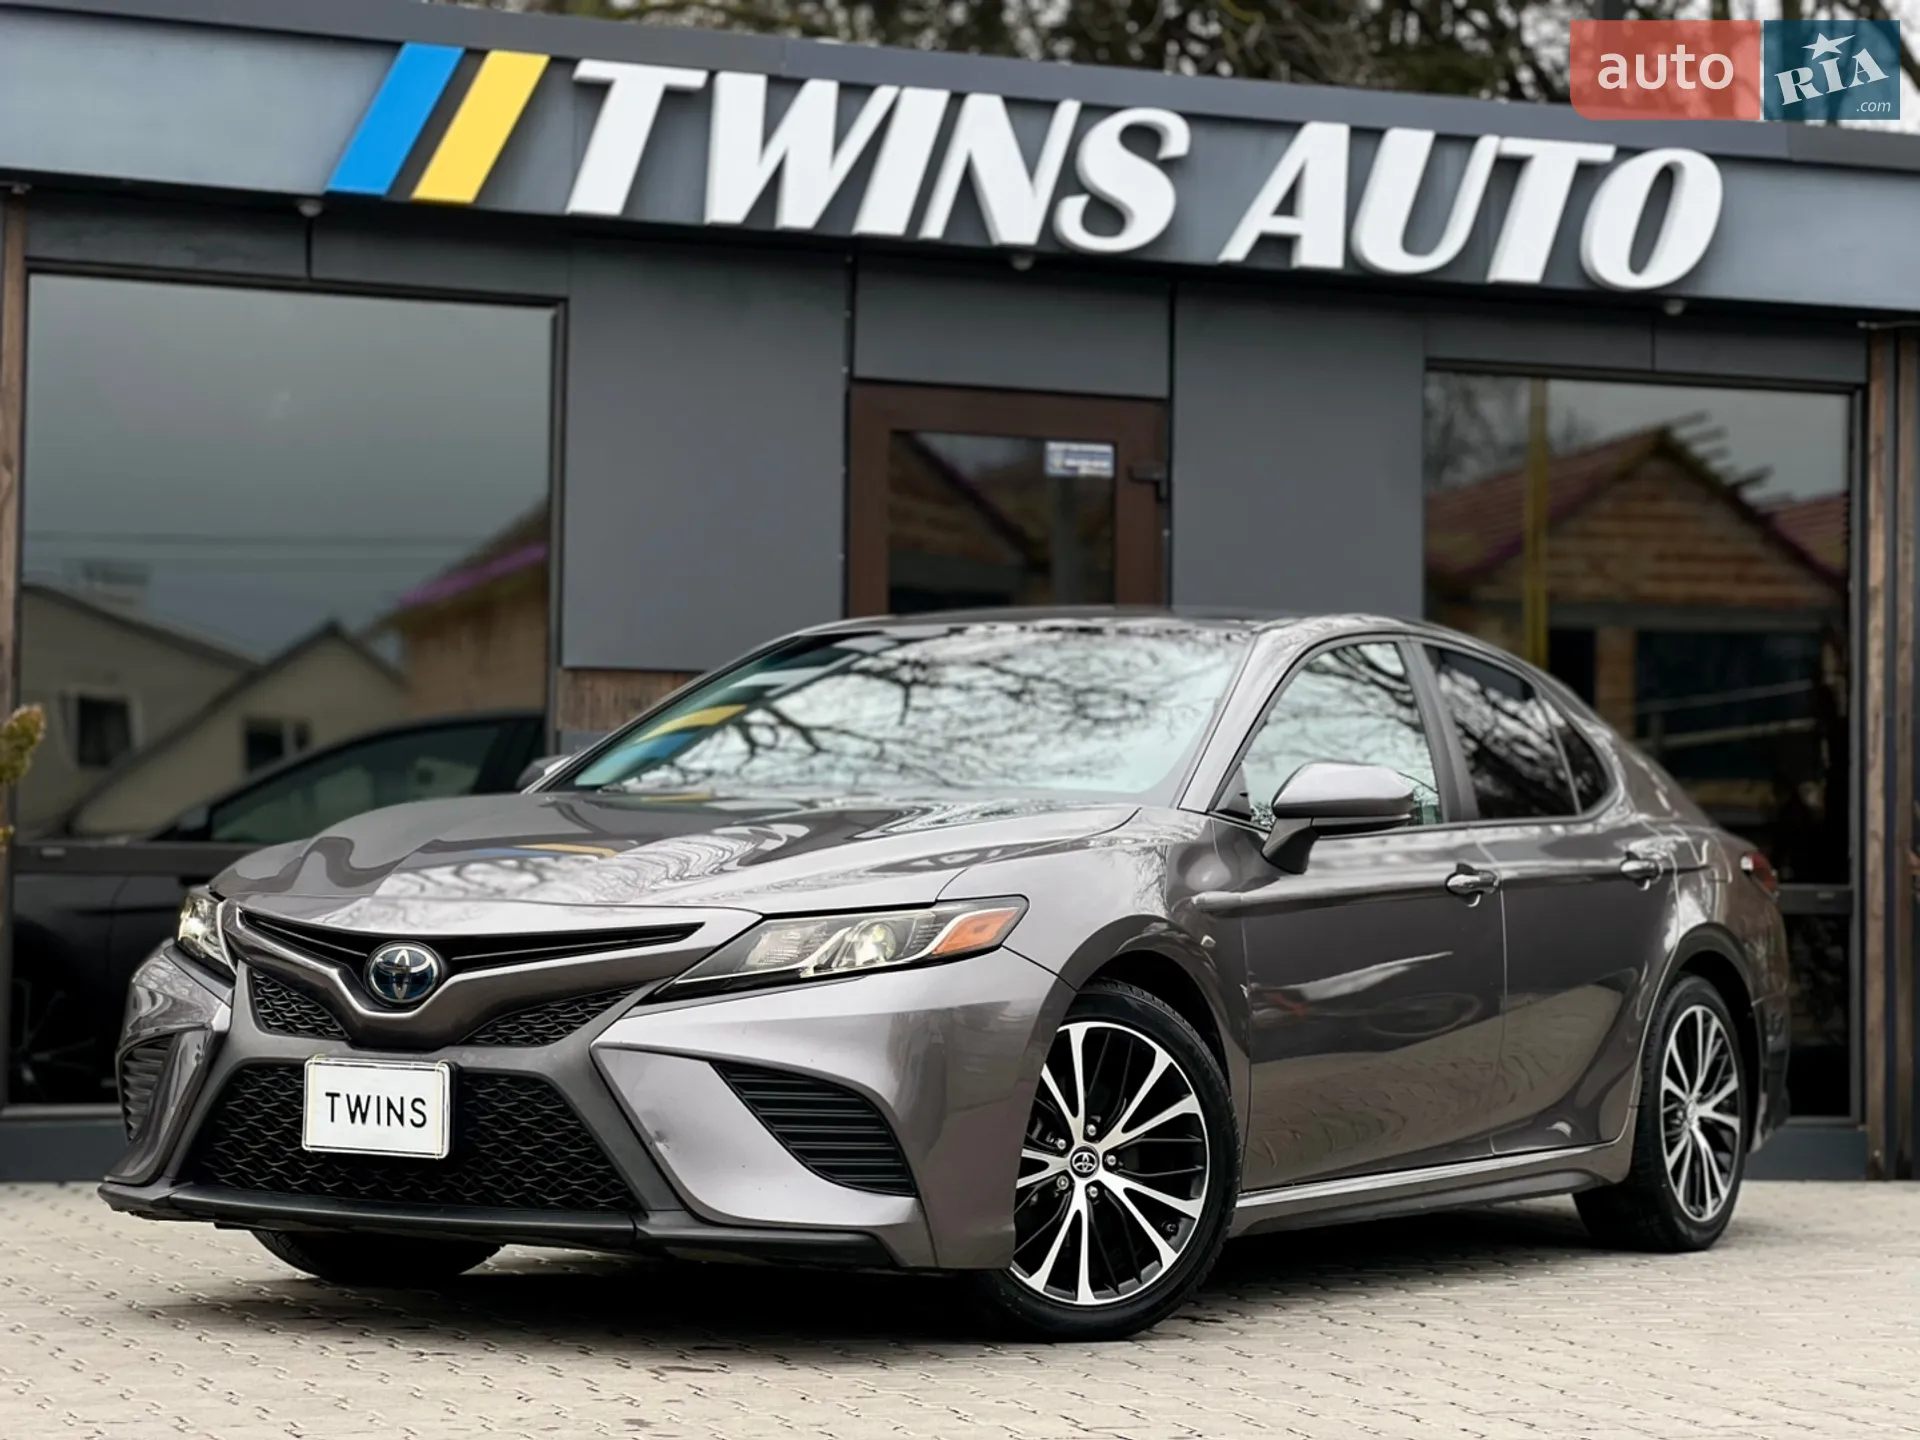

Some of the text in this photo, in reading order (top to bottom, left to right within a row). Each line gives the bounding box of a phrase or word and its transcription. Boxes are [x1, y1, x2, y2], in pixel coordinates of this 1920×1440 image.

[566, 59, 1723, 292] TWINS AUTO
[324, 1091, 428, 1128] TWINS
